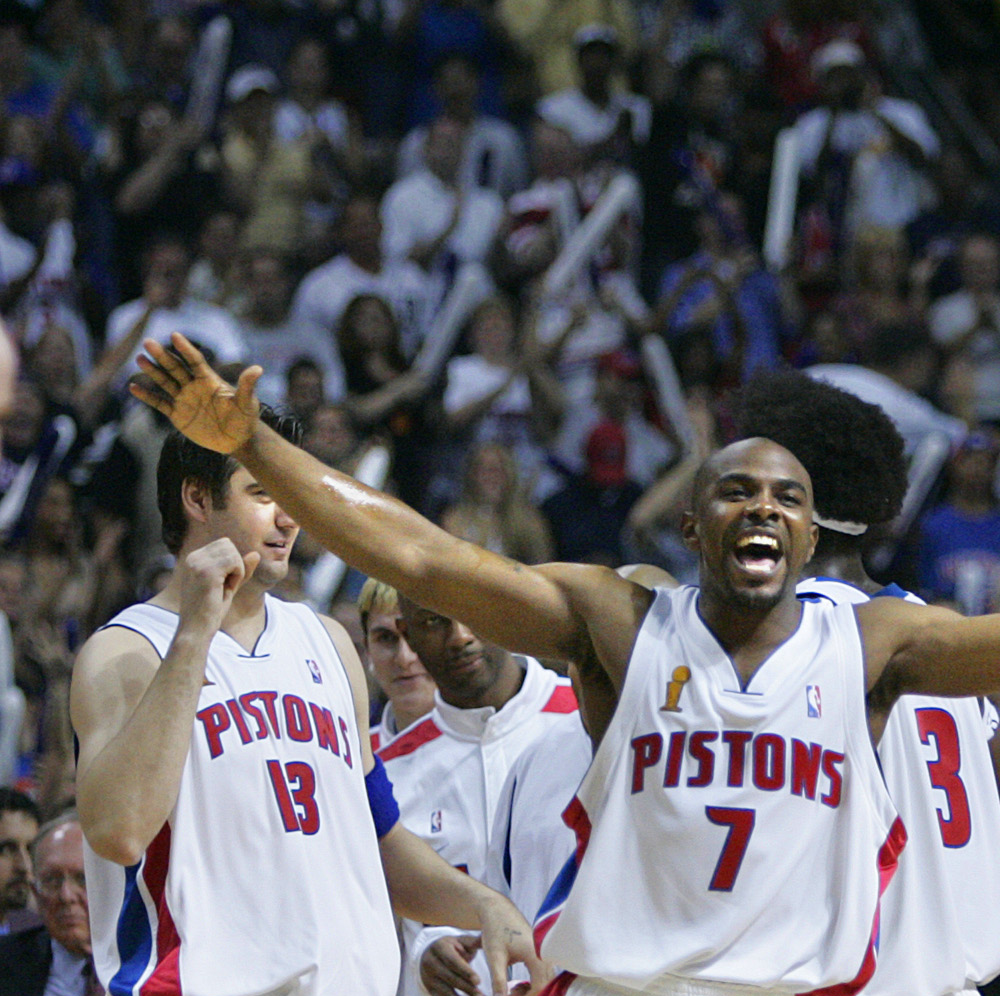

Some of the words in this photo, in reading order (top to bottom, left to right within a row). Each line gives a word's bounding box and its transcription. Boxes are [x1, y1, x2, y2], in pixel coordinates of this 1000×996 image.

[196, 690, 353, 769] PISTONS
[266, 759, 320, 836] 13
[631, 731, 845, 809] PISTONS
[914, 707, 972, 849] 3
[705, 805, 756, 892] 7
